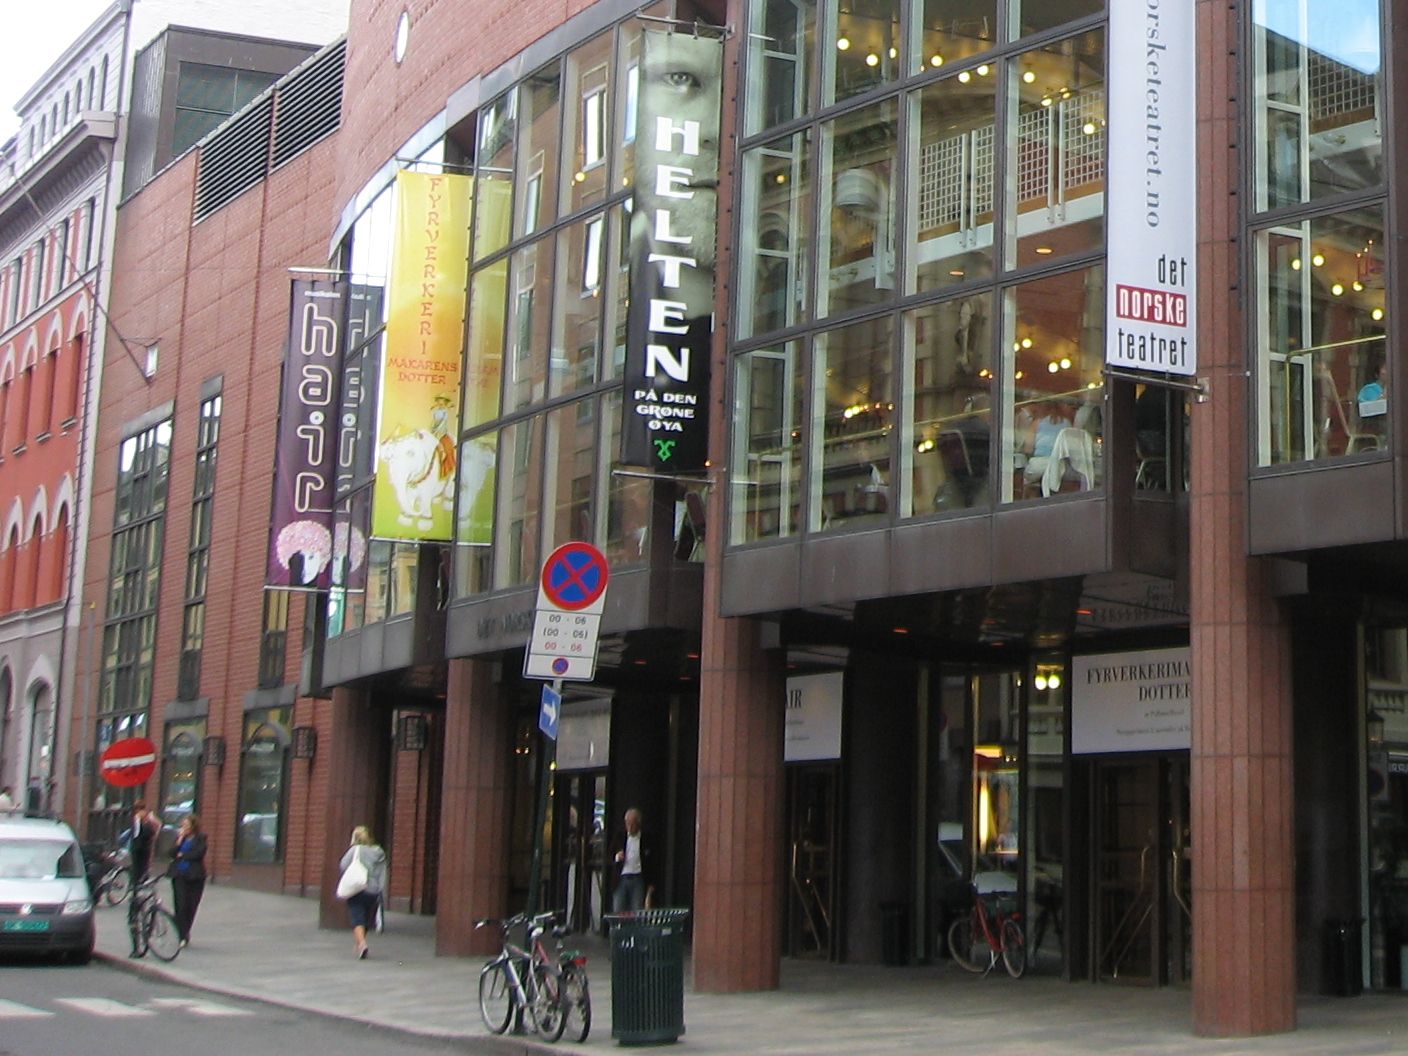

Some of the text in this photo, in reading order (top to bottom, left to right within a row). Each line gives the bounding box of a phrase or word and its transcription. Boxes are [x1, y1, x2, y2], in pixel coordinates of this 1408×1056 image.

[645, 116, 700, 382] HELTEN
[421, 178, 442, 355] FYRVERKERI
[1157, 254, 1187, 286] det
[1120, 288, 1184, 325] norske
[1118, 328, 1187, 366] teatret
[388, 357, 457, 372] MAKARENS
[399, 372, 446, 384] DOTTER
[634, 388, 697, 404] PÅ DEN
[295, 302, 338, 513] hair
[636, 404, 695, 419] GRØNE
[648, 419, 683, 432] ØYA
[549, 615, 561, 623] 00
[544, 642, 557, 650] 00
